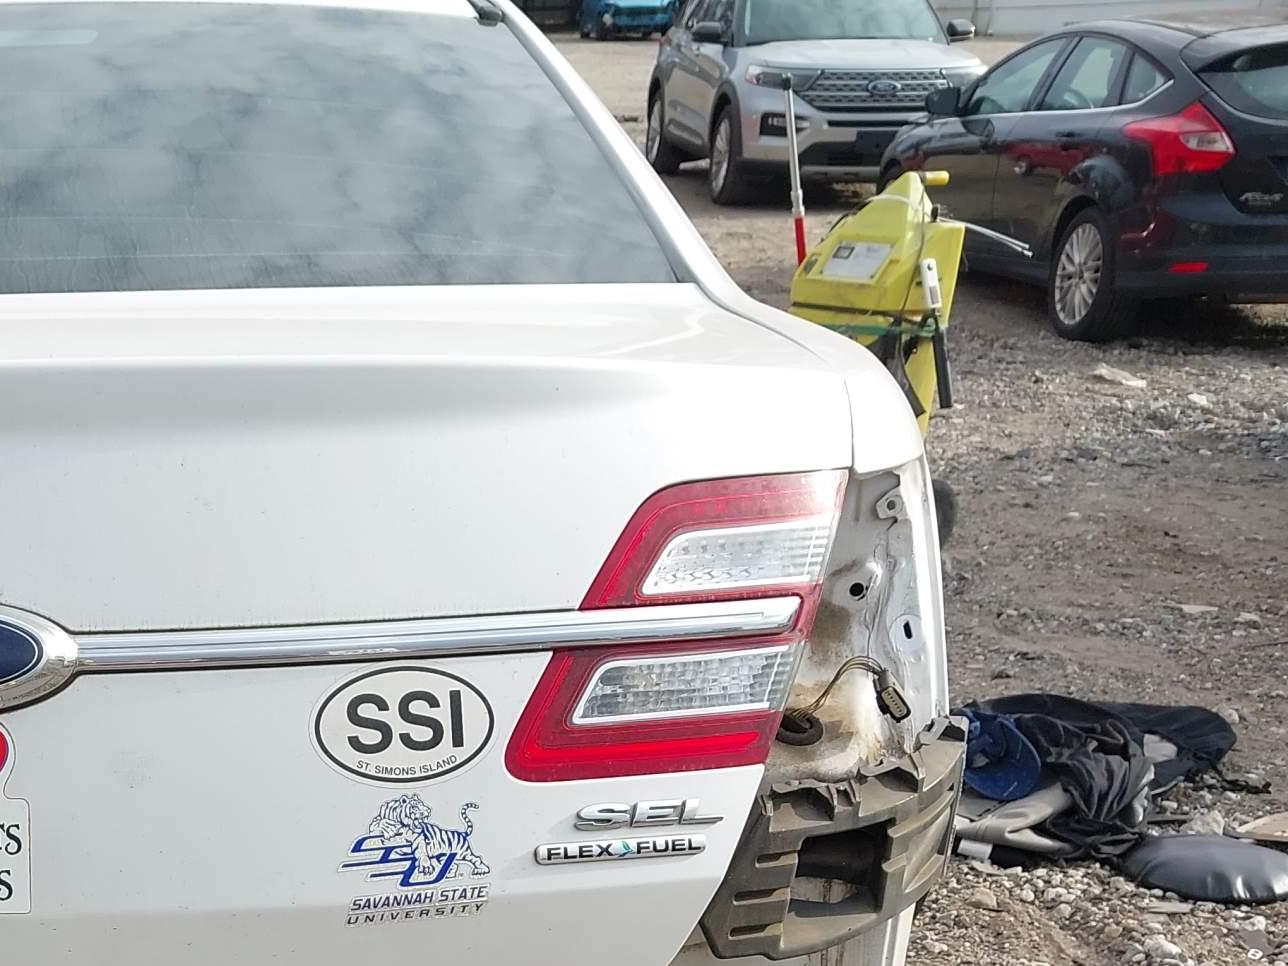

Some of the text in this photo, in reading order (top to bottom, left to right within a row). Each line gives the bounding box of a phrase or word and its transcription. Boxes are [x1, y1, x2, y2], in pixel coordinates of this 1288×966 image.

[347, 690, 464, 754] SSI
[356, 755, 458, 776] ST. SIMONS ISLAND
[574, 799, 725, 831] SEL
[546, 838, 704, 861] FLEX FUEL
[351, 886, 488, 911] SAVANNAH STATE
[347, 903, 484, 925] UNIVERSITY
